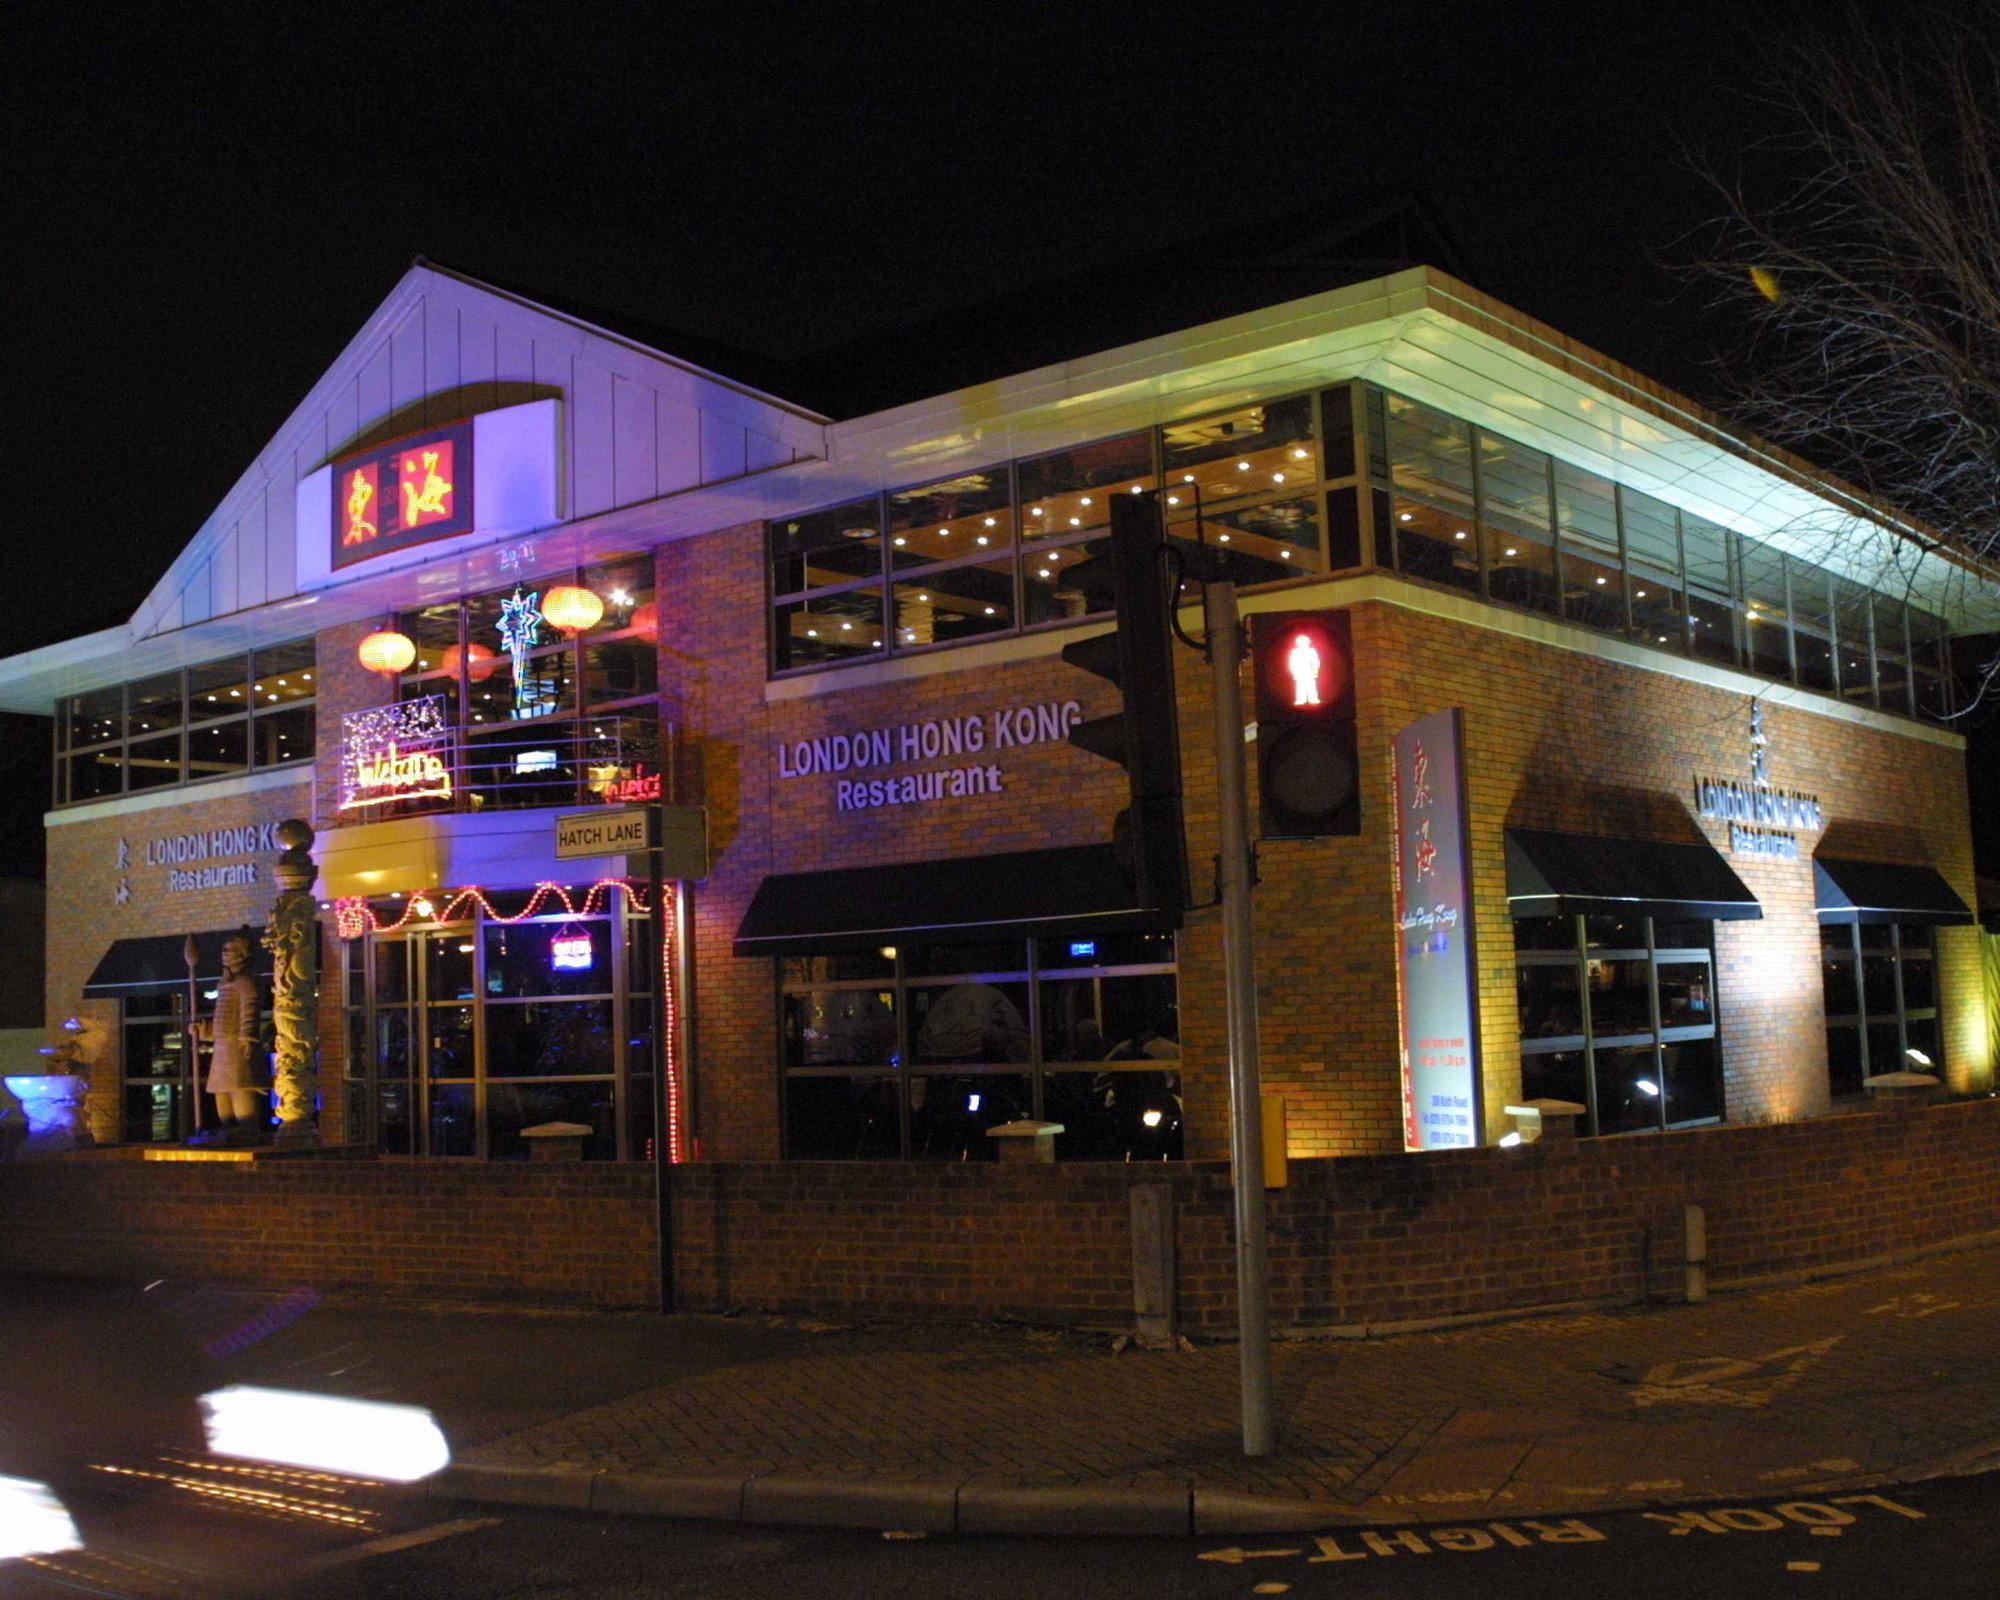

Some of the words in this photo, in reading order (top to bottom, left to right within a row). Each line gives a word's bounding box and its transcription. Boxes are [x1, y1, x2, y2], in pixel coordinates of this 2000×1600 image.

[779, 728, 892, 778] LONDON
[900, 715, 984, 762] HONG
[837, 764, 1003, 811] Restaurant
[147, 832, 209, 867] LONDON
[211, 824, 257, 859] HONG
[559, 828, 602, 847] HATCH
[607, 822, 642, 842] LANE
[170, 863, 257, 892] Restaurant
[1642, 1495, 1927, 1535] LOOK
[1307, 1519, 1607, 1563] RIGHT
